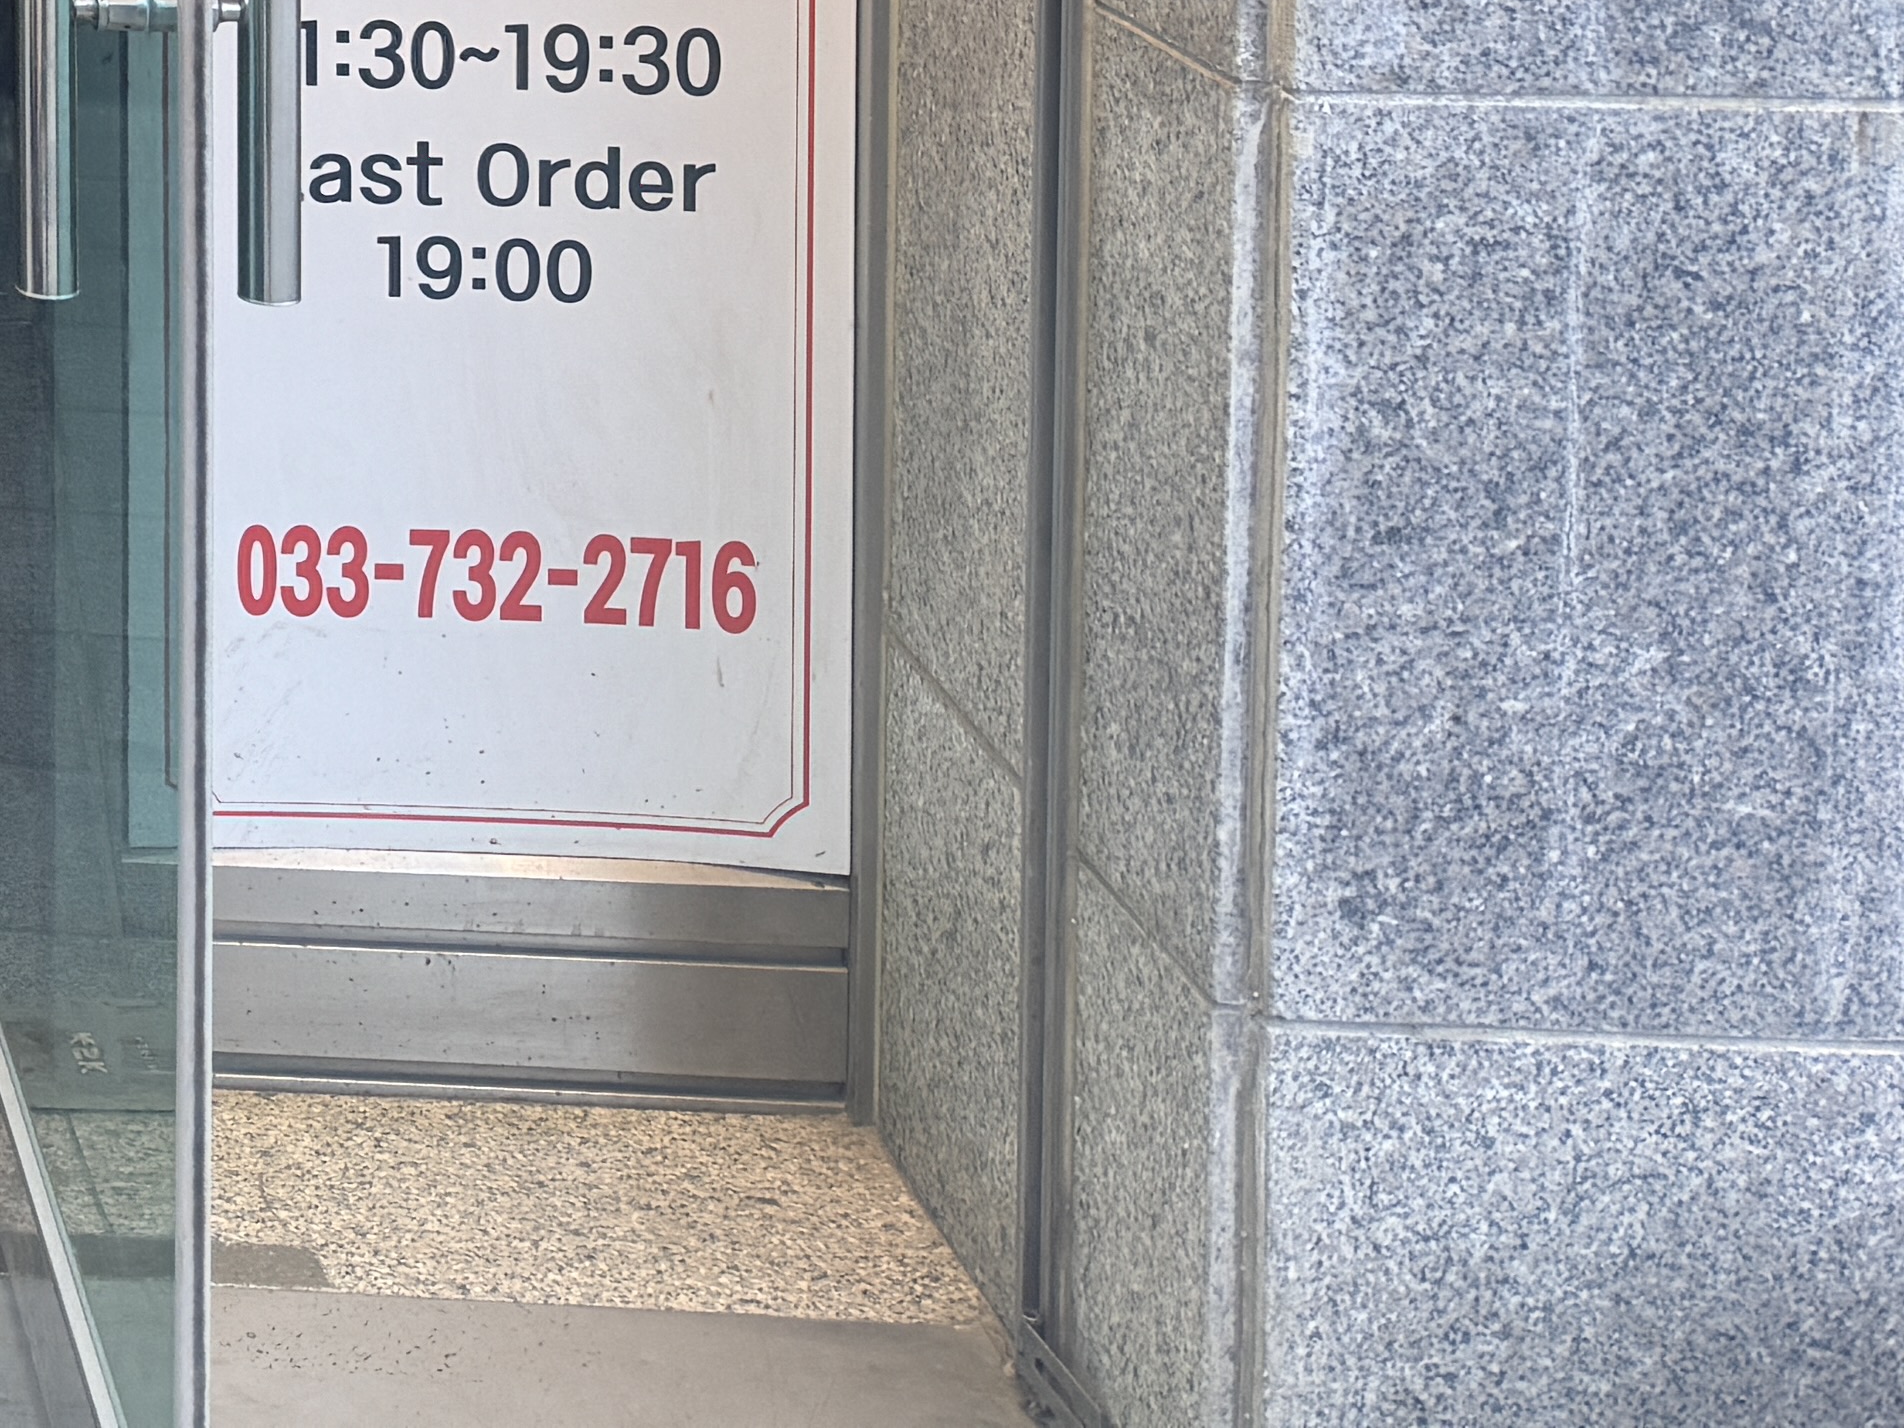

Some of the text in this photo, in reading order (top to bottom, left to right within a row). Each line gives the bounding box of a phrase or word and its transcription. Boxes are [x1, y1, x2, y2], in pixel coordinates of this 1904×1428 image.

[301, 19, 722, 97] 1:30~19:30
[301, 141, 717, 213] ast Order
[376, 234, 593, 304] 19:00
[237, 524, 758, 634] 033-732-2716
